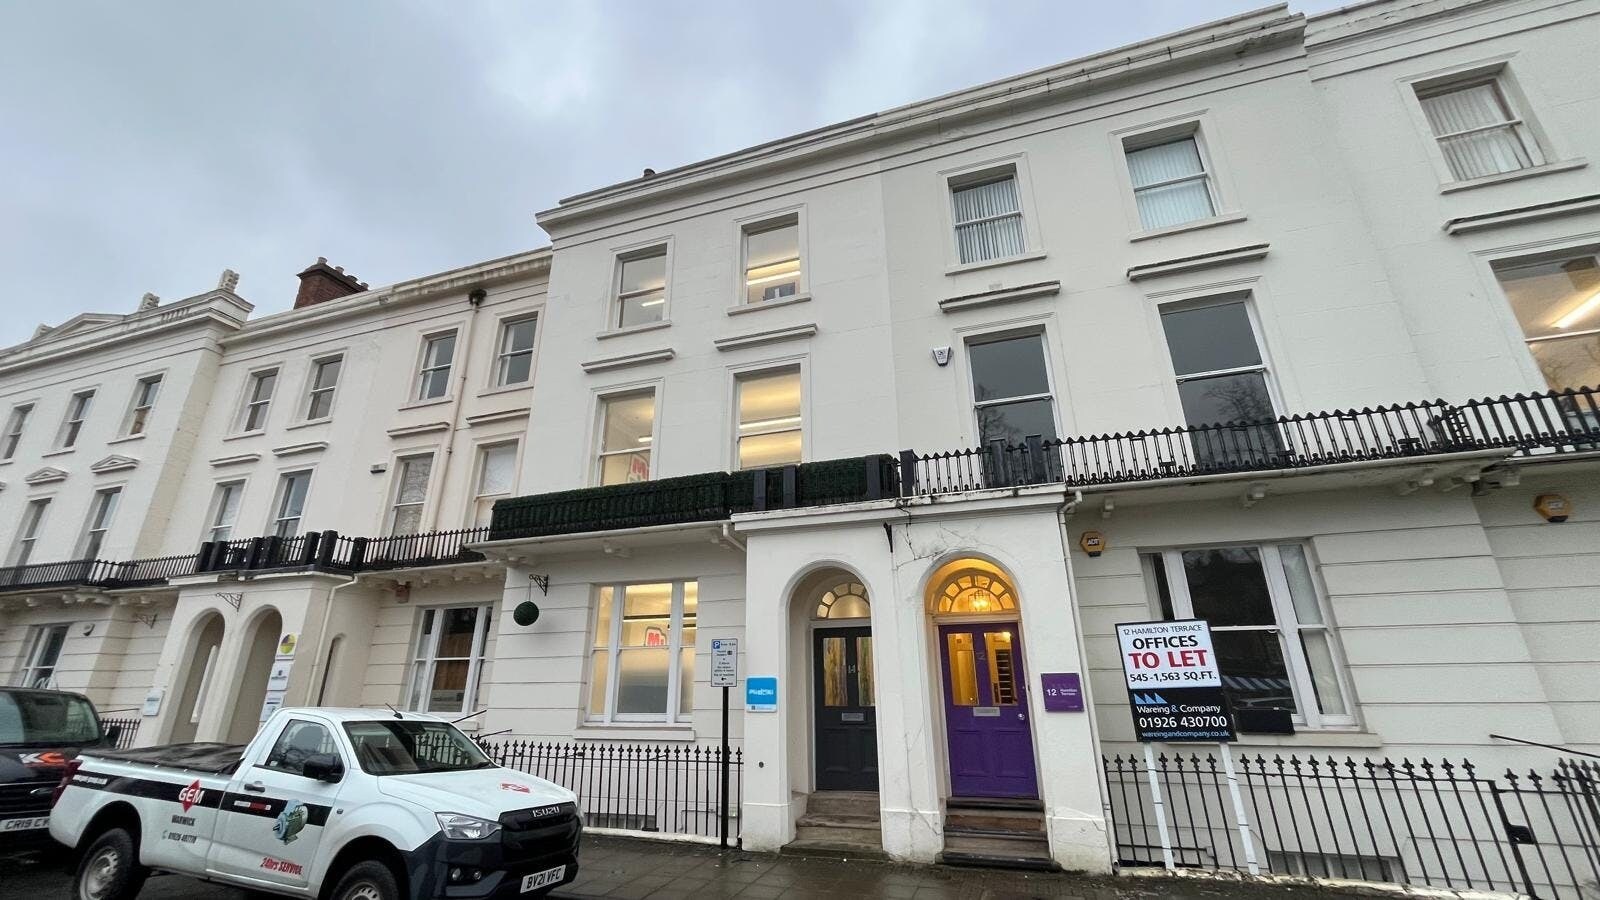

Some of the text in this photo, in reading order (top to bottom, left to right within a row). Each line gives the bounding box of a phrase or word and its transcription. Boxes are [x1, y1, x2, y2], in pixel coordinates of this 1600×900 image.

[1131, 626, 1170, 635] HAMILTON
[1171, 624, 1202, 633] TERRACE
[1132, 635, 1199, 649] OFFICES
[1128, 650, 1208, 669] TO LET
[1130, 671, 1217, 683] 545-1,563 SQ.FT.
[1136, 705, 1170, 715] Wareing
[1179, 704, 1221, 714] Company
[1139, 716, 1228, 728] 01926 430700
[1141, 730, 1230, 739] wareingandcompany.co.uk
[178, 787, 205, 804] GEM
[532, 806, 560, 818] ISUZU
[5, 819, 32, 830] CR19
[171, 815, 196, 826] WARWICK
[278, 861, 304, 875] SERVICE
[526, 867, 562, 889] BV21 VFC
